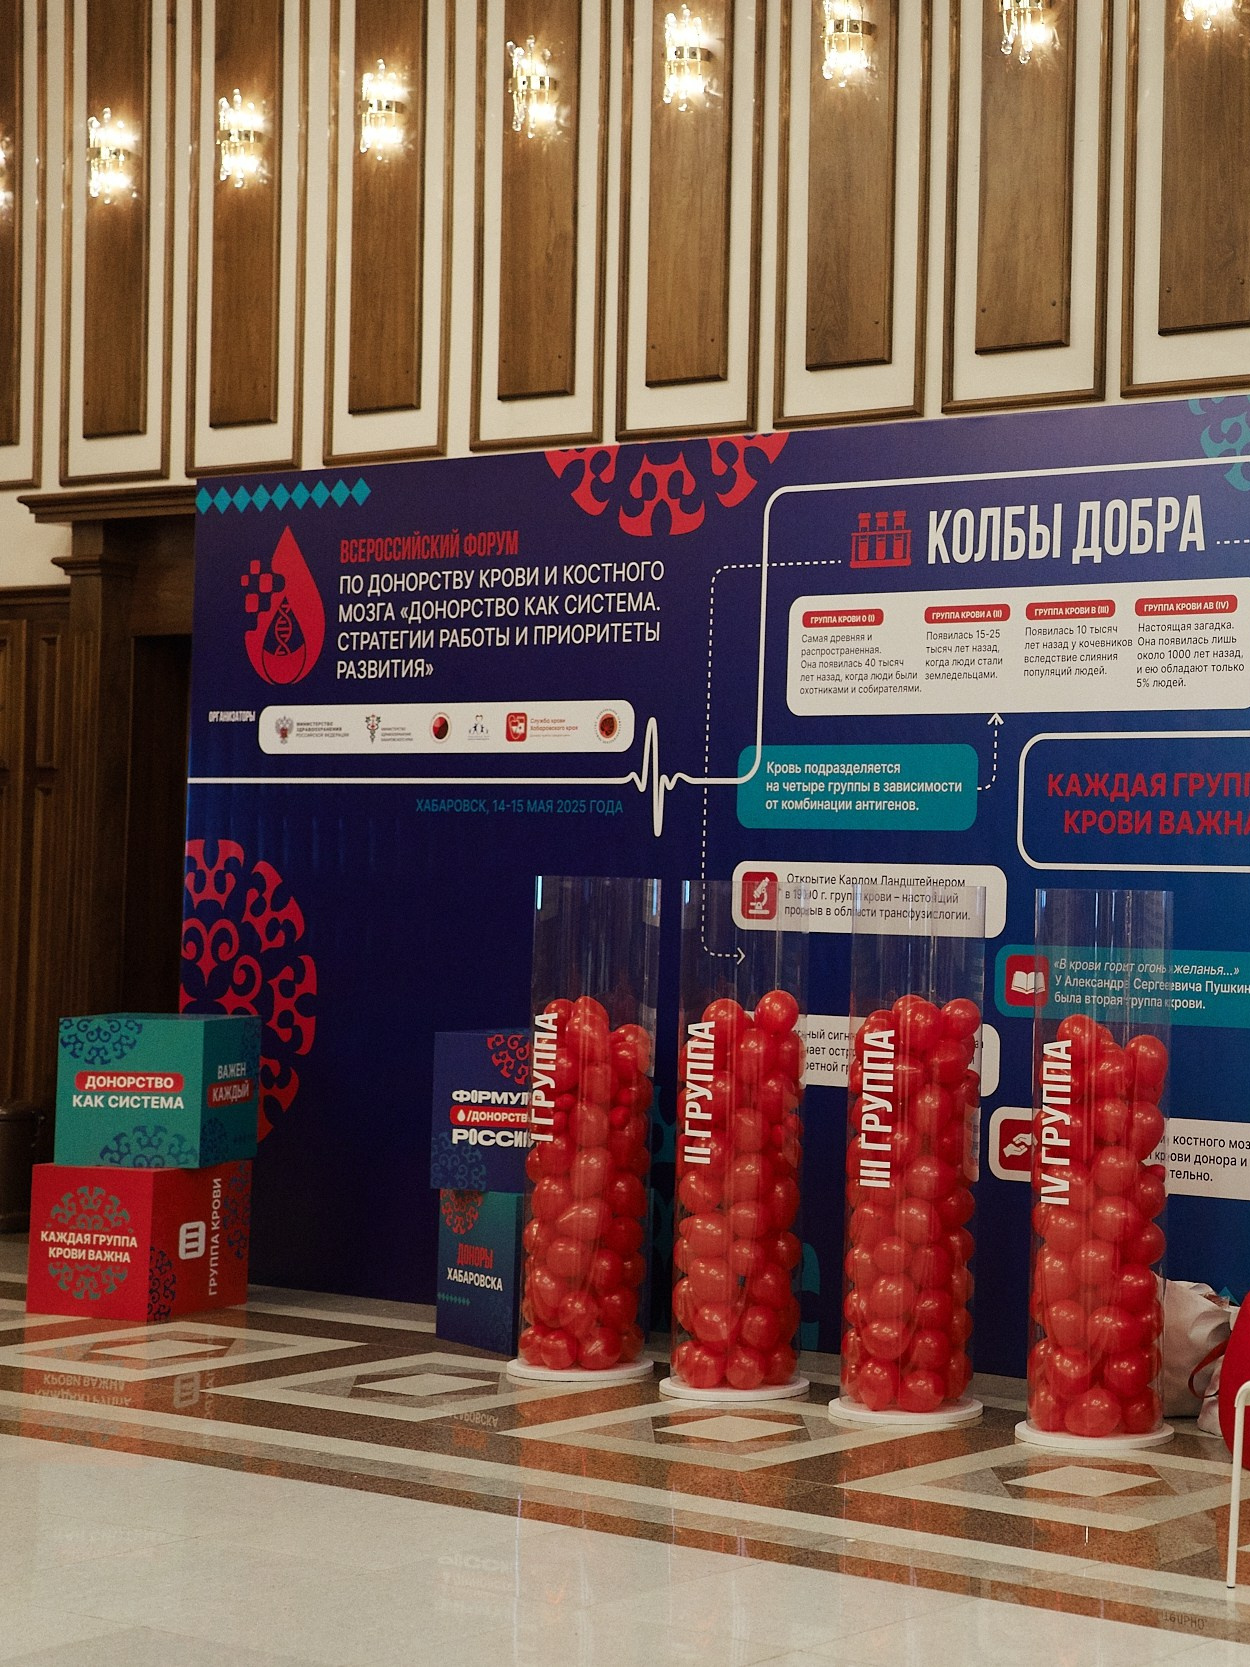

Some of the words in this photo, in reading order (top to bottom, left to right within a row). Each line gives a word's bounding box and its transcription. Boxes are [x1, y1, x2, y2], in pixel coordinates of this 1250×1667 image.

[928, 503, 1062, 564] КОЛБЫ
[1072, 495, 1205, 563] ДОБРА
[340, 529, 460, 564] ВСЕРОССИЙСКИЙ
[464, 530, 519, 557] ФОРУМ
[340, 575, 363, 594] ПО
[368, 570, 474, 597] ДОНОРСТВУ
[480, 567, 538, 588] КРОВИ
[545, 566, 557, 585] И
[564, 561, 664, 584] КОСТНОГО
[339, 603, 395, 622] МОЗГА
[401, 597, 519, 623] «ДОНОРСТВО
[525, 596, 559, 615] КАК
[565, 592, 660, 614] СИСТЕМА.
[1144, 603, 1174, 612] ГРУППА
[1176, 602, 1202, 611] КРОВИ
[1215, 600, 1229, 610] (IV)
[338, 630, 434, 651] СТРАТЕГИИ
[440, 627, 509, 647] РАБОТЫ
[516, 627, 528, 645] И
[534, 622, 660, 645] ПРИОРИТЕТЫ
[1139, 624, 1191, 632] Настоящая
[1195, 622, 1234, 631] загадка.
[1138, 637, 1155, 646] Она
[1159, 637, 1208, 645] появилась
[1137, 652, 1165, 660] около
[1168, 650, 1190, 658] 1000
[1213, 650, 1243, 658] назад,
[337, 659, 433, 679] РАЗВИТИЯ»
[1161, 664, 1208, 674] обладают
[1137, 678, 1149, 687] 5%
[1153, 678, 1186, 688] людей.
[208, 711, 256, 723] ОРГАНИЗАТОРЫ
[767, 762, 801, 776] Кровь
[805, 764, 900, 776] подразделяется
[767, 782, 779, 791] на
[783, 782, 825, 794] четыре
[828, 782, 870, 794] группы
[874, 782, 880, 791] в
[883, 782, 962, 792] зависимости
[1048, 773, 1166, 802] КАЖДАЯ
[416, 799, 489, 814] ХАБАРОВСК,
[493, 800, 523, 812] 14-15
[527, 800, 553, 812] МАЯ
[557, 800, 586, 813] 2025
[590, 800, 623, 816] ГОДА
[766, 800, 778, 809] от
[782, 798, 852, 812] комбинации
[855, 801, 919, 810] антигенов.
[1065, 810, 1151, 834] КРОВИ
[217, 1062, 246, 1080] ВАЖЕН
[532, 1012, 558, 1126] ГРУППА
[85, 1075, 174, 1090] ДОНОРСТВО
[684, 1021, 715, 1137] ГРУППА
[212, 1080, 249, 1104] КАЖДЫЙ
[860, 1029, 895, 1151] ГРУППА
[72, 1095, 105, 1108] КАК
[108, 1095, 184, 1110] СИСТЕМА
[1041, 1039, 1072, 1165] ГРУППА
[1173, 1135, 1226, 1148] костного
[684, 1145, 711, 1164] II
[1194, 1153, 1237, 1168] донора
[1240, 1158, 1247, 1167] и
[860, 1159, 891, 1188] III
[1040, 1174, 1070, 1206] IV
[211, 1178, 222, 1230] КРОВИ
[40, 1230, 90, 1246] КАЖДАЯ
[92, 1233, 138, 1248] ГРУППА
[48, 1247, 86, 1261] КРОВИ
[87, 1249, 131, 1263] ВАЖНА
[209, 1233, 220, 1296] ГРУППА
[456, 1243, 493, 1269] ДОНОРЫ
[447, 1267, 503, 1291] ХАБАРОВСКА
